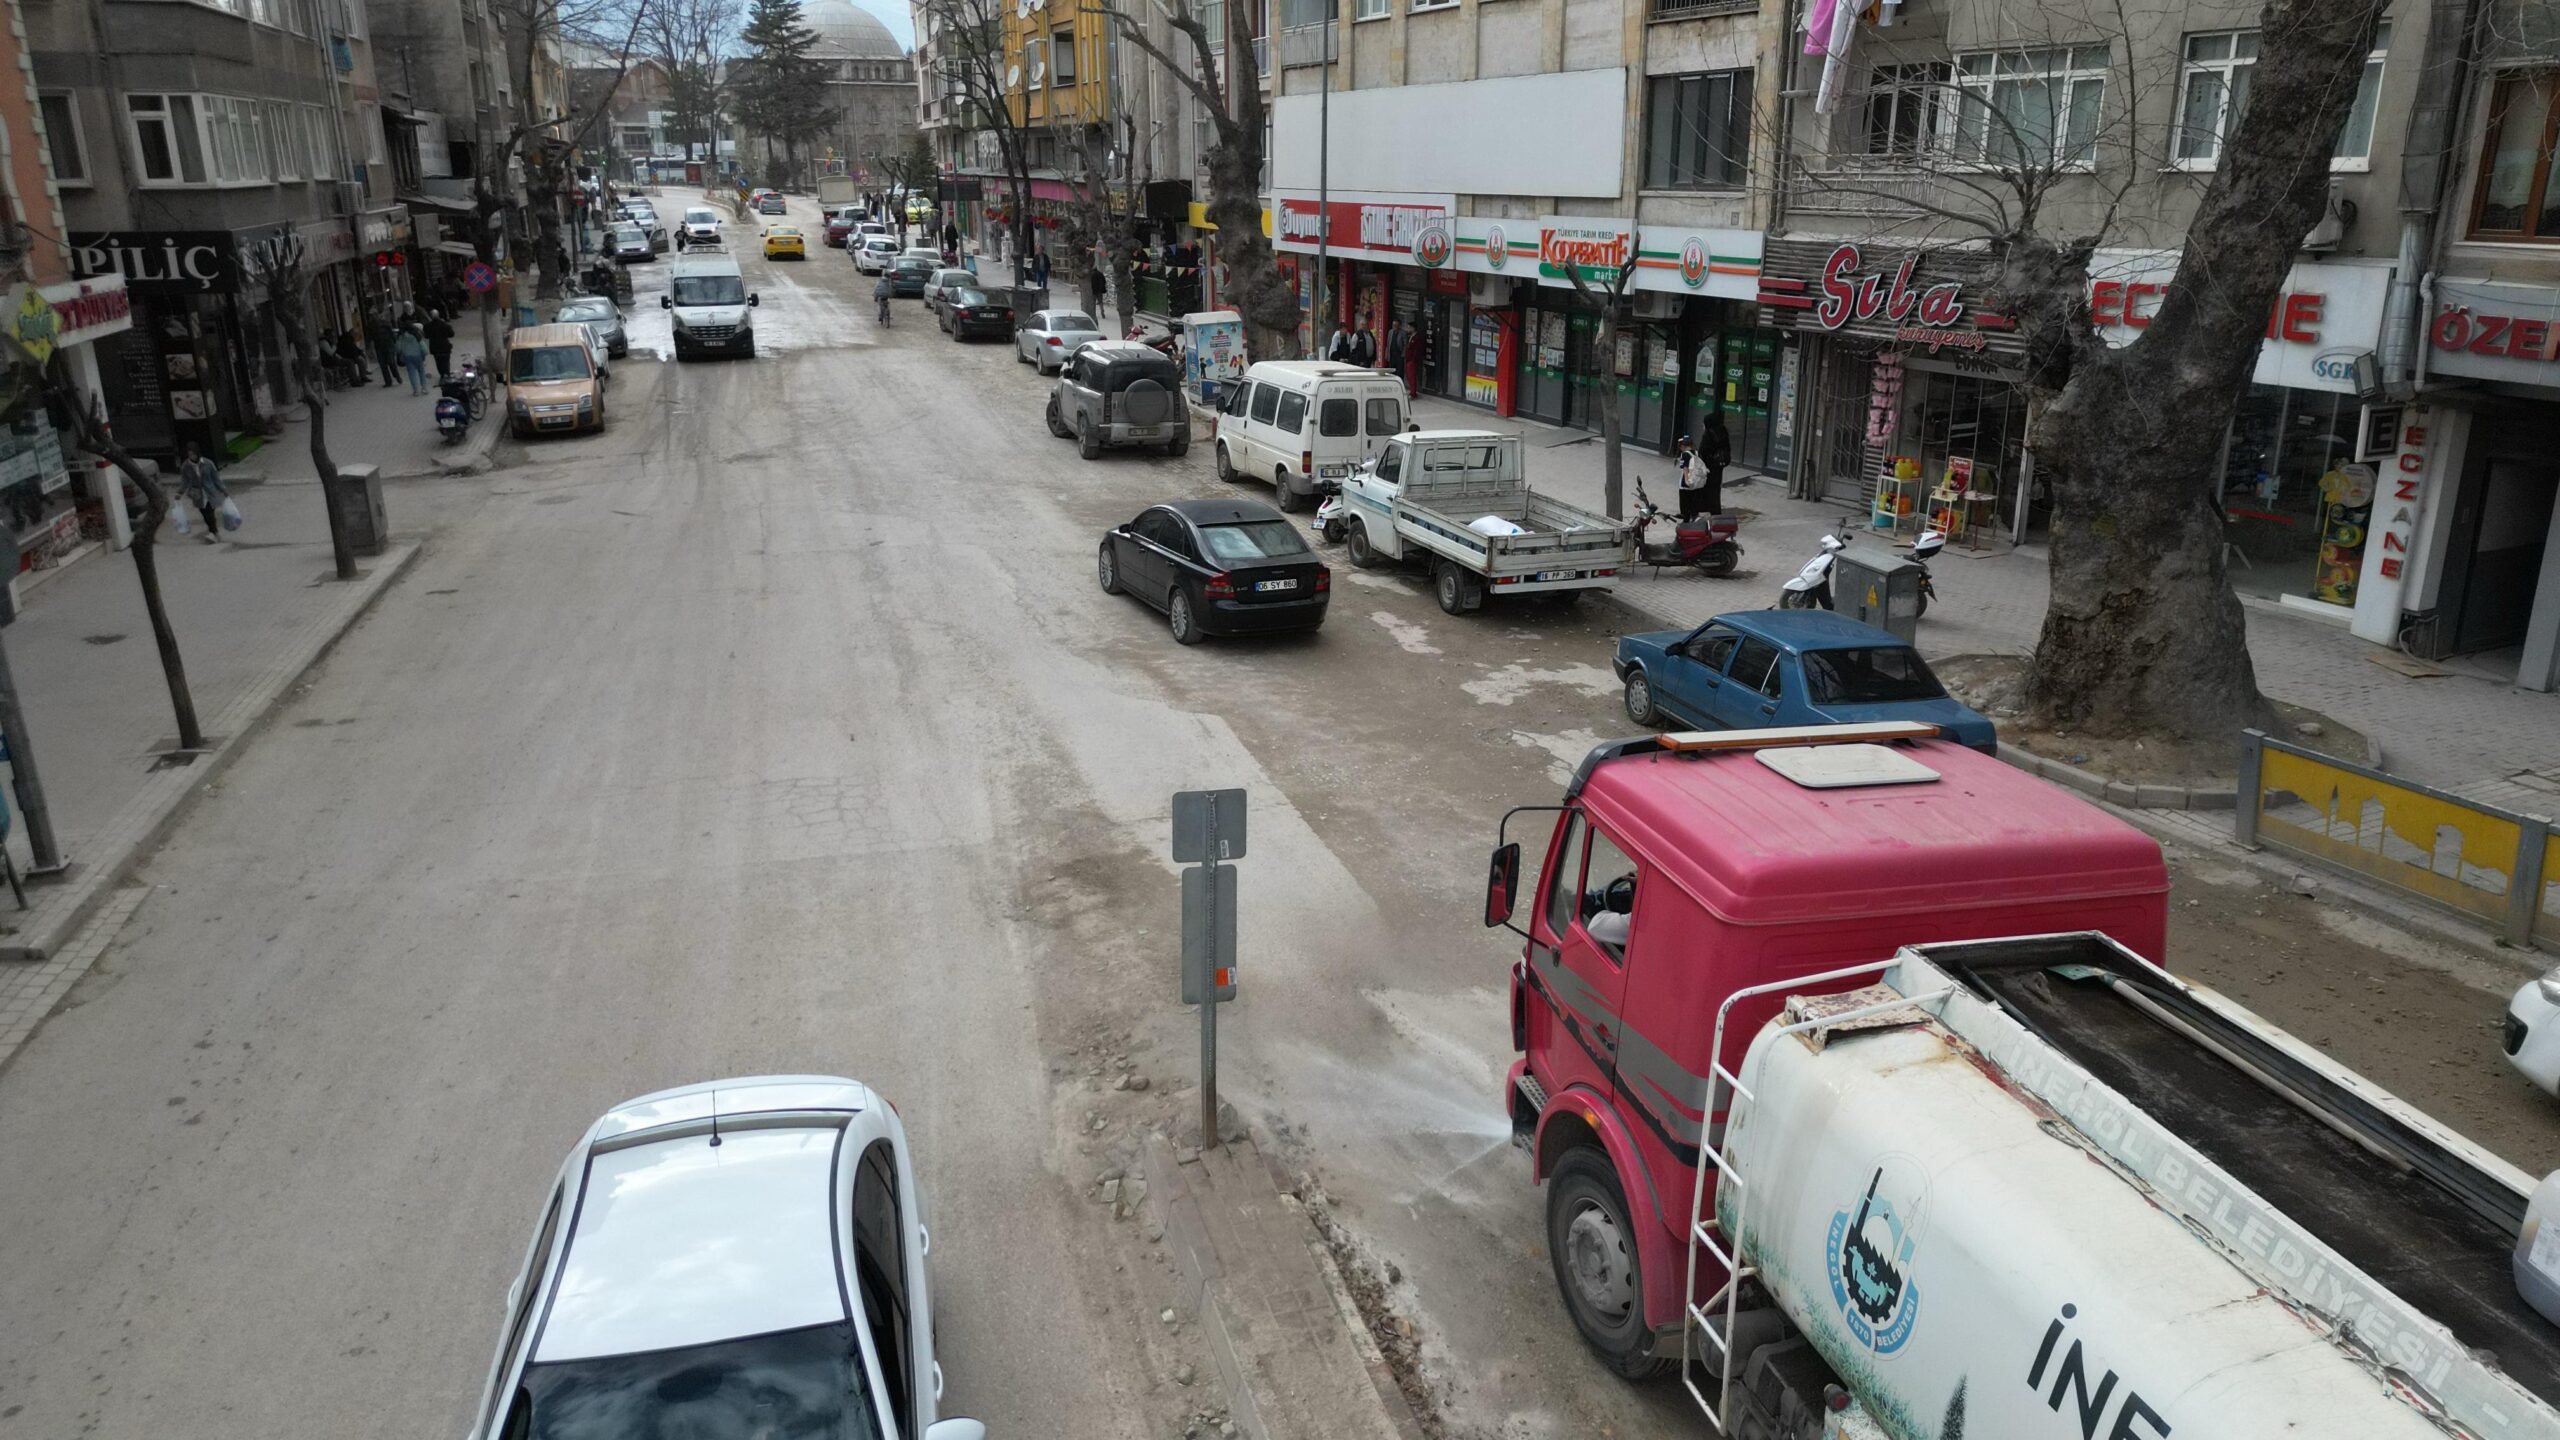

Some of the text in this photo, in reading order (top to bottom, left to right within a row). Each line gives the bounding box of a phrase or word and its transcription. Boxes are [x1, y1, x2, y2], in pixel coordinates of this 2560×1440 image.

[1580, 229, 1597, 239] TARIM
[78, 237, 220, 289] PİLİÇ
[2431, 303, 2560, 361] ÖZE
[2380, 425, 2428, 580] ECZANE
[1270, 581, 1281, 589] SY
[2155, 1152, 2457, 1390] BELEDİYESİ
